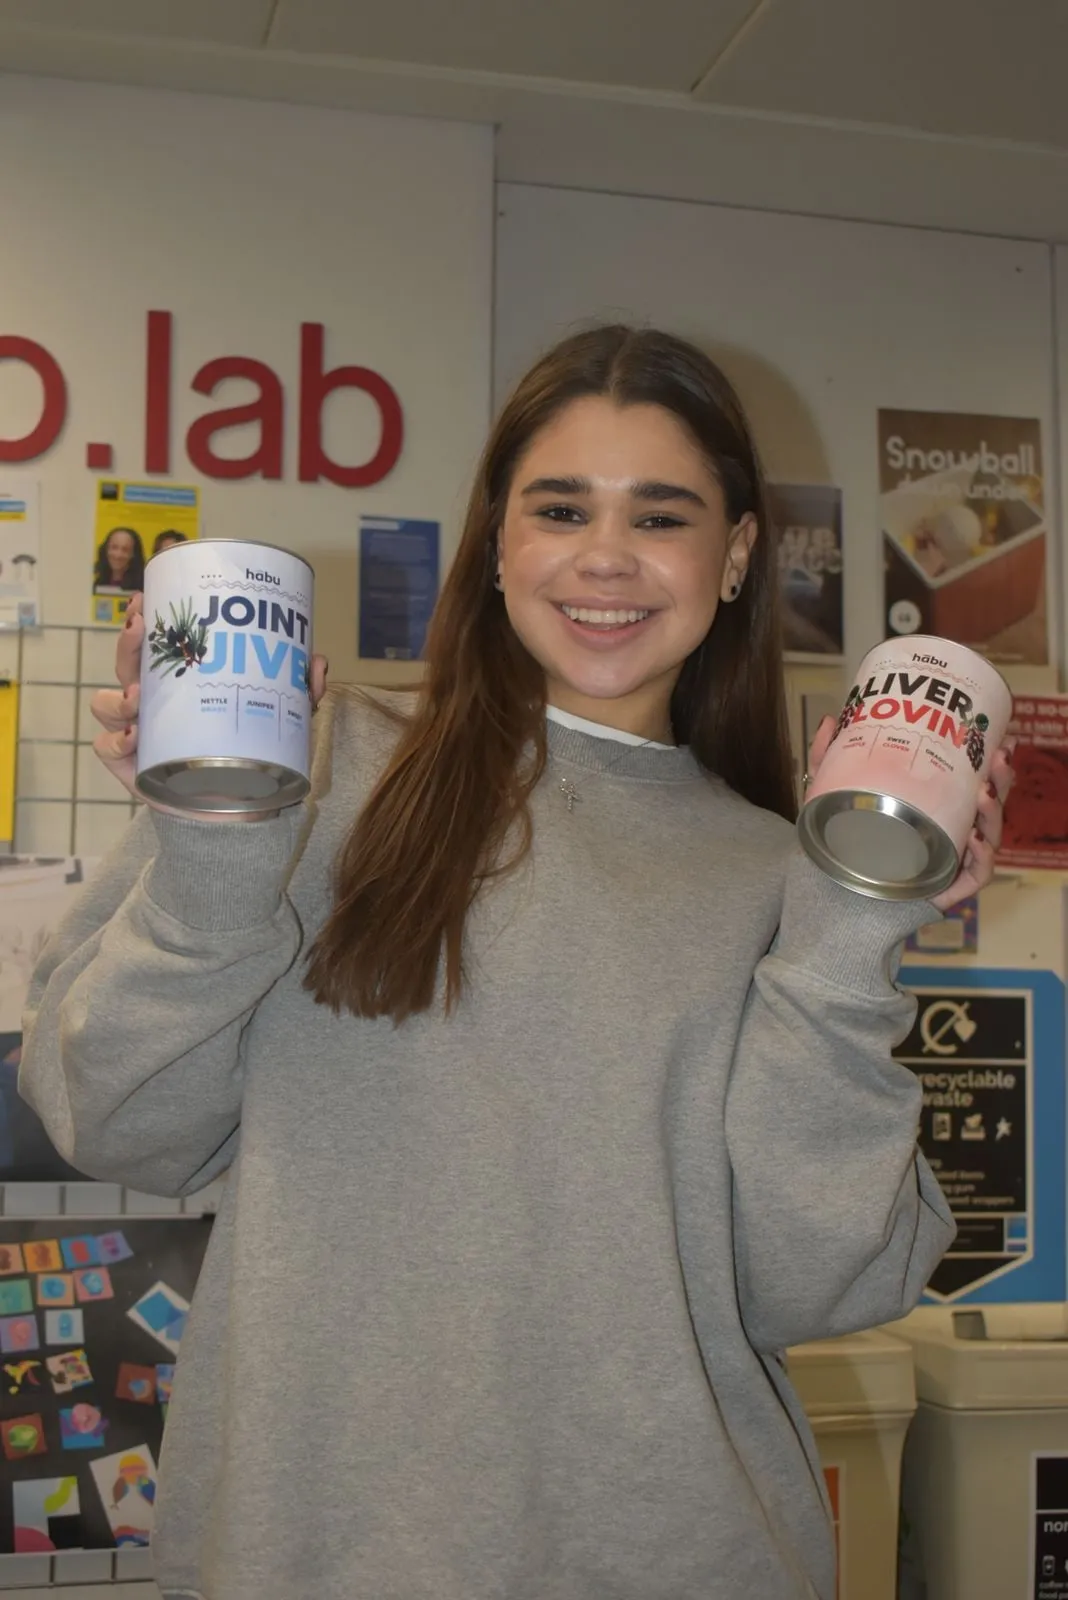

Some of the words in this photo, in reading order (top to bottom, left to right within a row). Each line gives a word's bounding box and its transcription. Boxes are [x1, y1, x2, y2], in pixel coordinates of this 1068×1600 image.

[886, 436, 1034, 475] Snowball
[198, 595, 309, 645] JOINT
[197, 631, 307, 695] JIVE
[863, 673, 973, 722] LIVER
[852, 698, 967, 749] LOVIN
